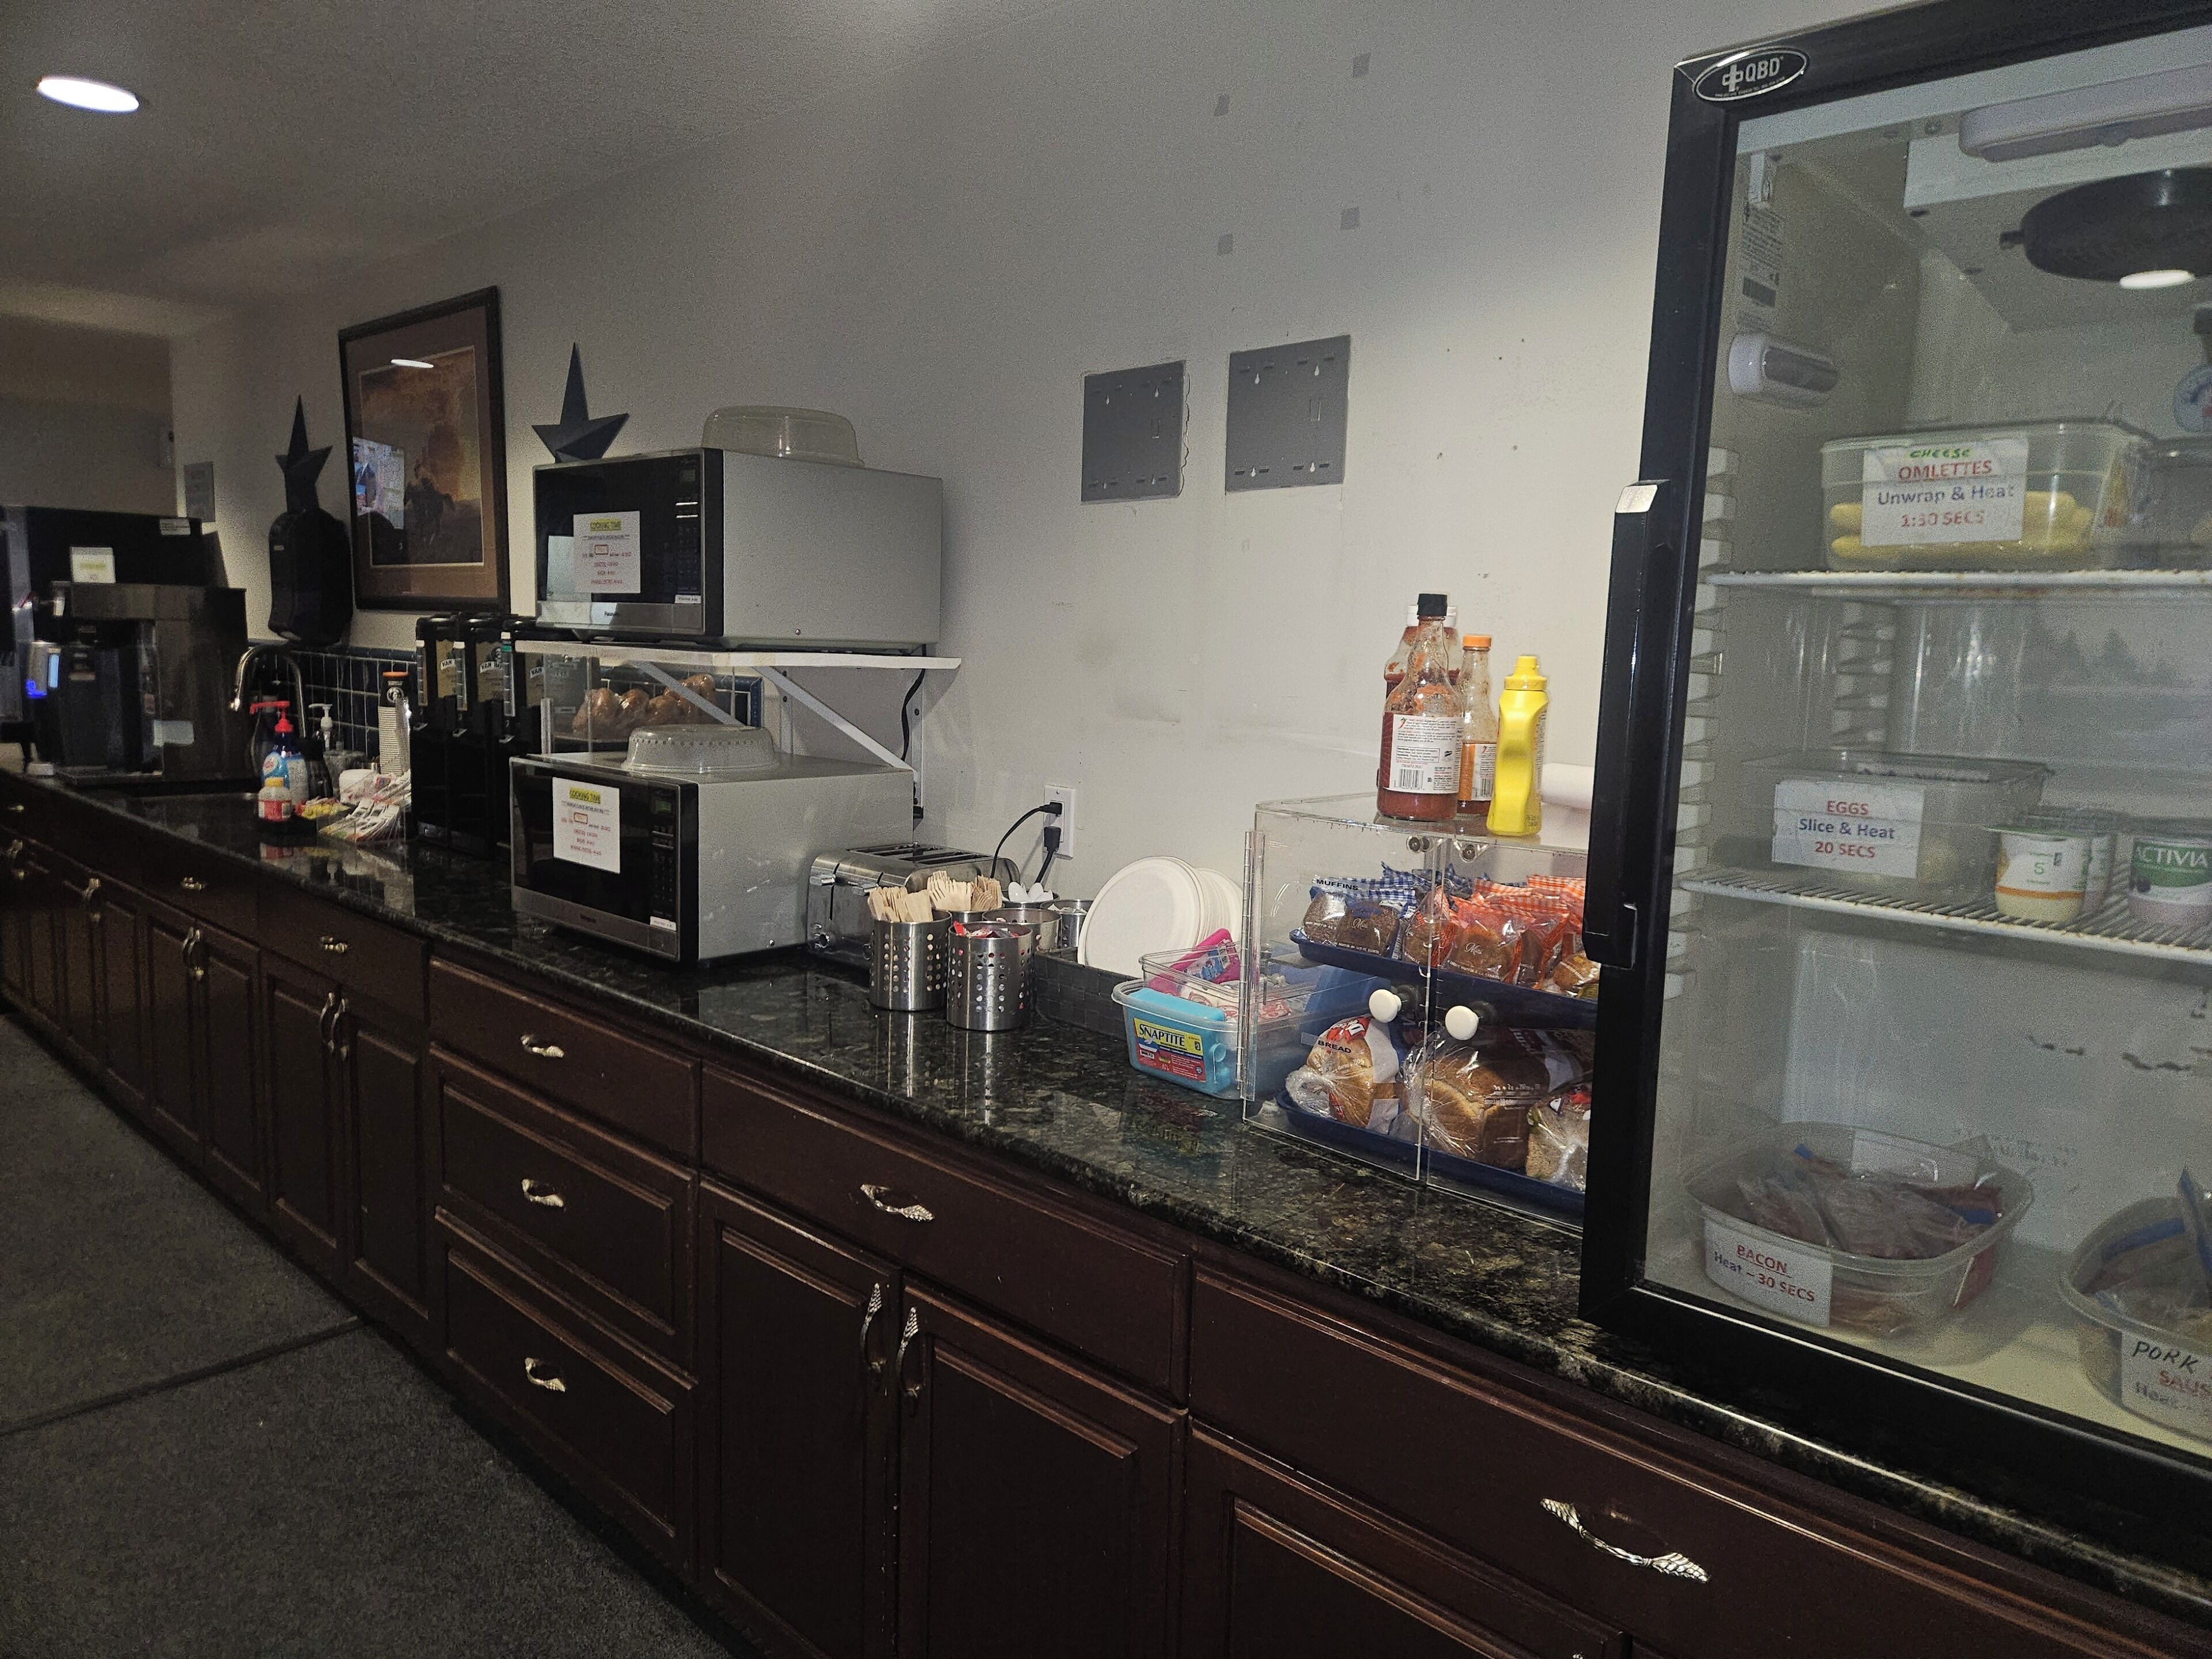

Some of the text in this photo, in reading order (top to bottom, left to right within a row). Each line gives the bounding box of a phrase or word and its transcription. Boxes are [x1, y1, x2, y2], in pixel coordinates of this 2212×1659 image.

[1899, 461, 1993, 480] OMLETTES
[1878, 485, 2014, 505] Unwrap & Heat
[1902, 510, 1984, 528] 1:30 SECS
[1827, 800, 1869, 816] EGGS
[1798, 818, 1895, 840] Slice & Heat
[1815, 840, 1876, 859] 20 SECS
[1316, 878, 1359, 891] MUFFINS
[1139, 1024, 1185, 1047] SNAPTITE
[1317, 1040, 1351, 1053] BREAD
[1736, 1244, 1787, 1274] BACON
[1714, 1251, 1742, 1273] Heat
[1758, 1273, 1775, 1289] 30
[1780, 1281, 1815, 1302] SECS
[2133, 1340, 2199, 1374] PORK
